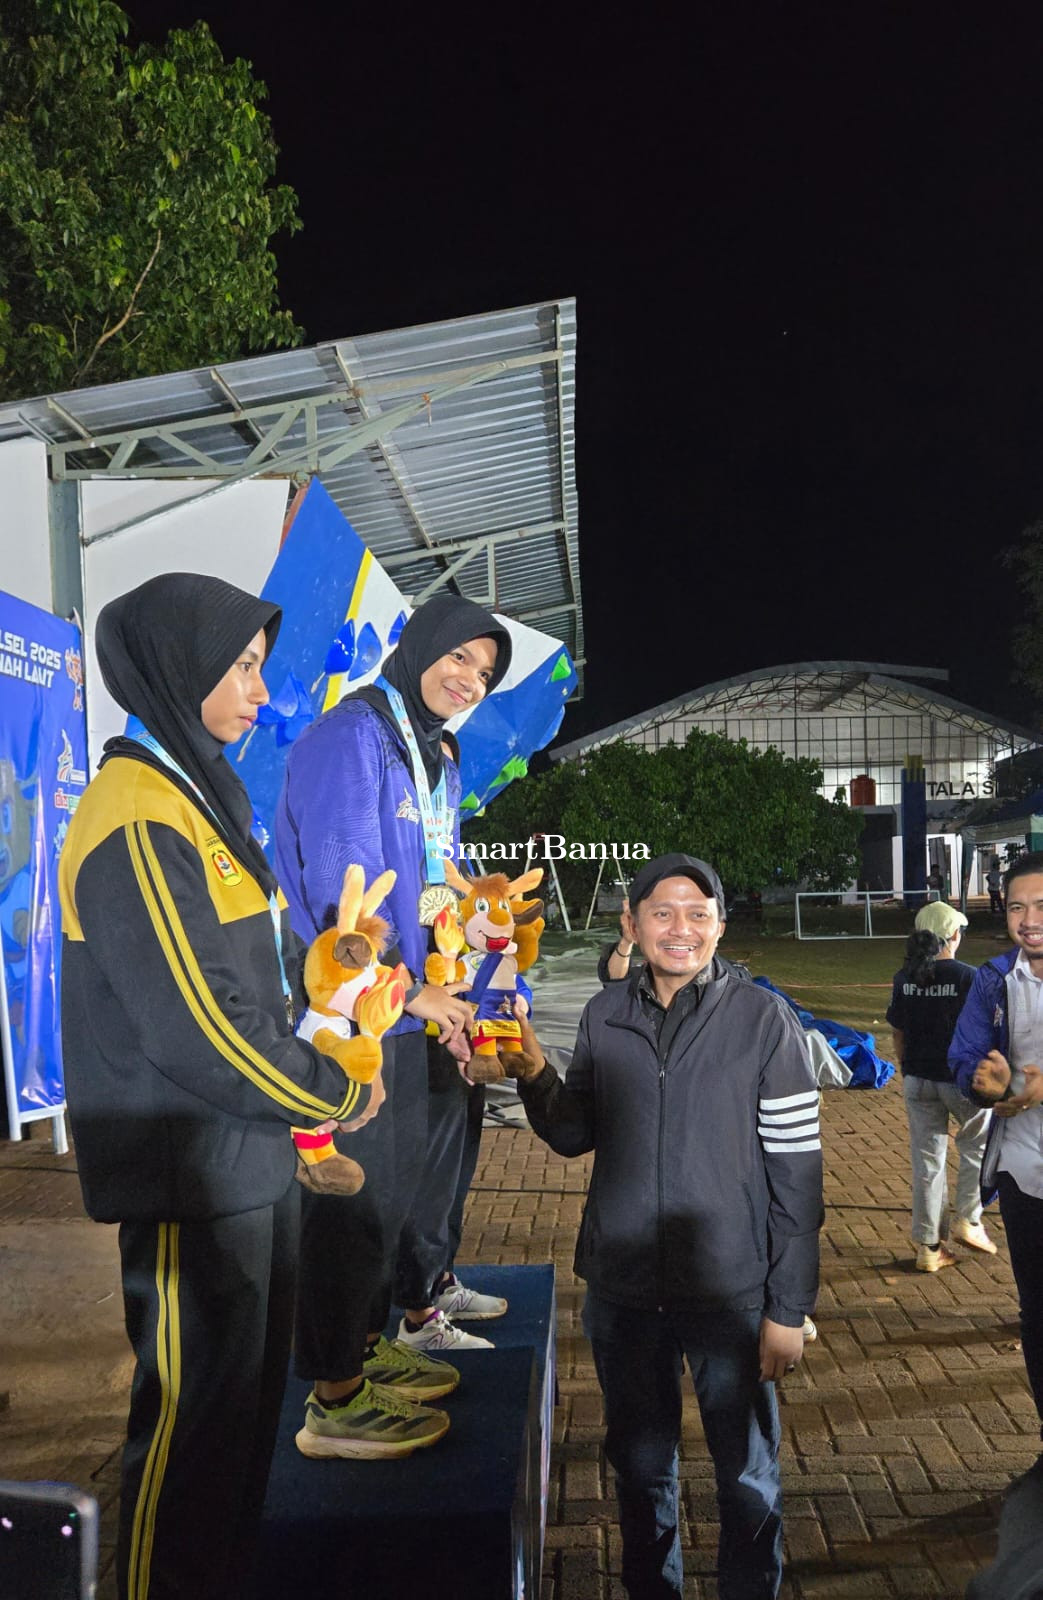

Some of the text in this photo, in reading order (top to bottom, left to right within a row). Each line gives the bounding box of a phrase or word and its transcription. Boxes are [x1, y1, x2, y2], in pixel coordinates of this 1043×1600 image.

[30, 641, 62, 671] 2025
[24, 661, 54, 688] LAUT
[926, 781, 975, 796] TALA
[902, 983, 958, 997] OFFICIAL
